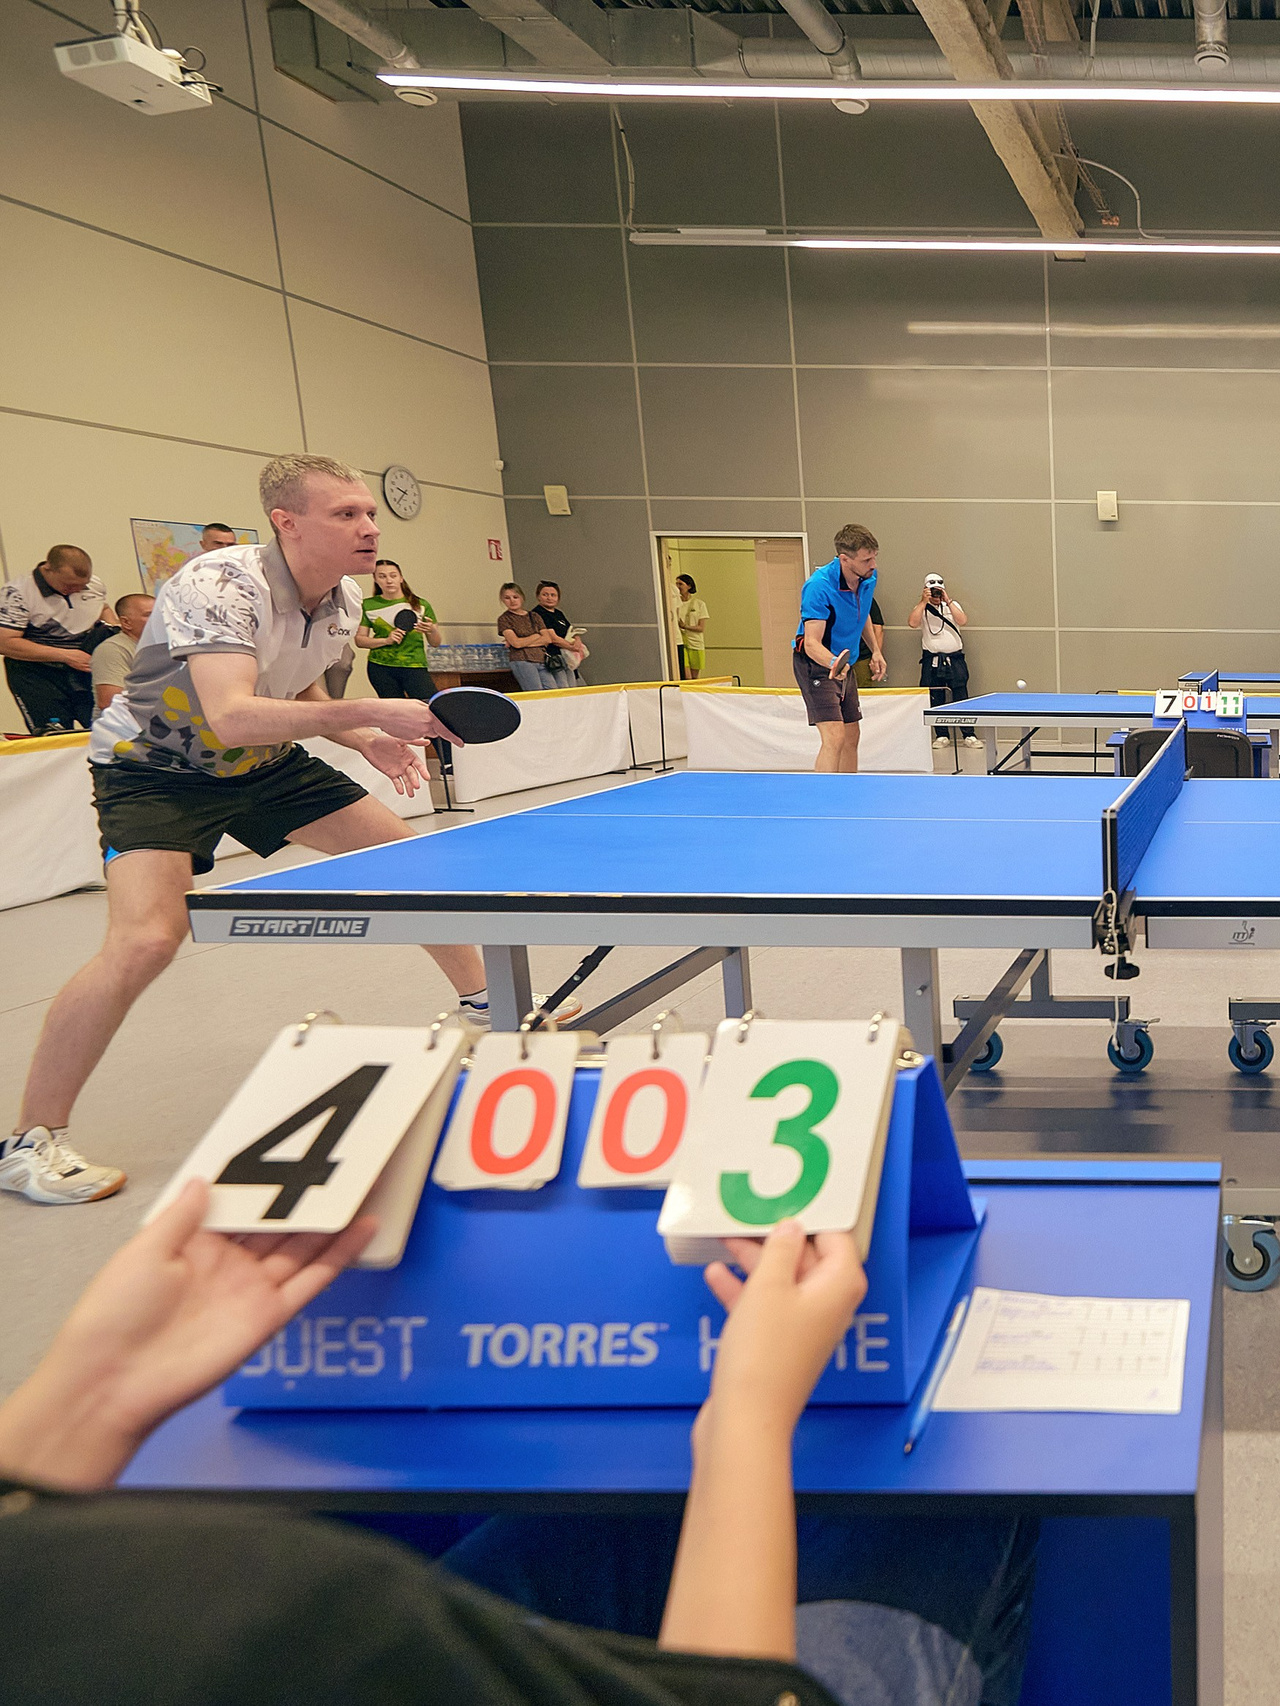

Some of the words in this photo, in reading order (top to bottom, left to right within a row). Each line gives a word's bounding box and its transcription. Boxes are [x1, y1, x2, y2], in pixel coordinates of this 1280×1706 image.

[1162, 695, 1177, 714] 7
[1184, 696, 1195, 708] 0
[1205, 696, 1211, 708] 1
[1221, 696, 1239, 714] 11
[233, 919, 312, 934] START
[317, 920, 364, 934] LINE
[213, 1063, 390, 1220] 4
[470, 1068, 558, 1175] 0
[600, 1068, 688, 1174] 0
[718, 1058, 839, 1226] 3
[460, 1321, 660, 1368] TORRES
